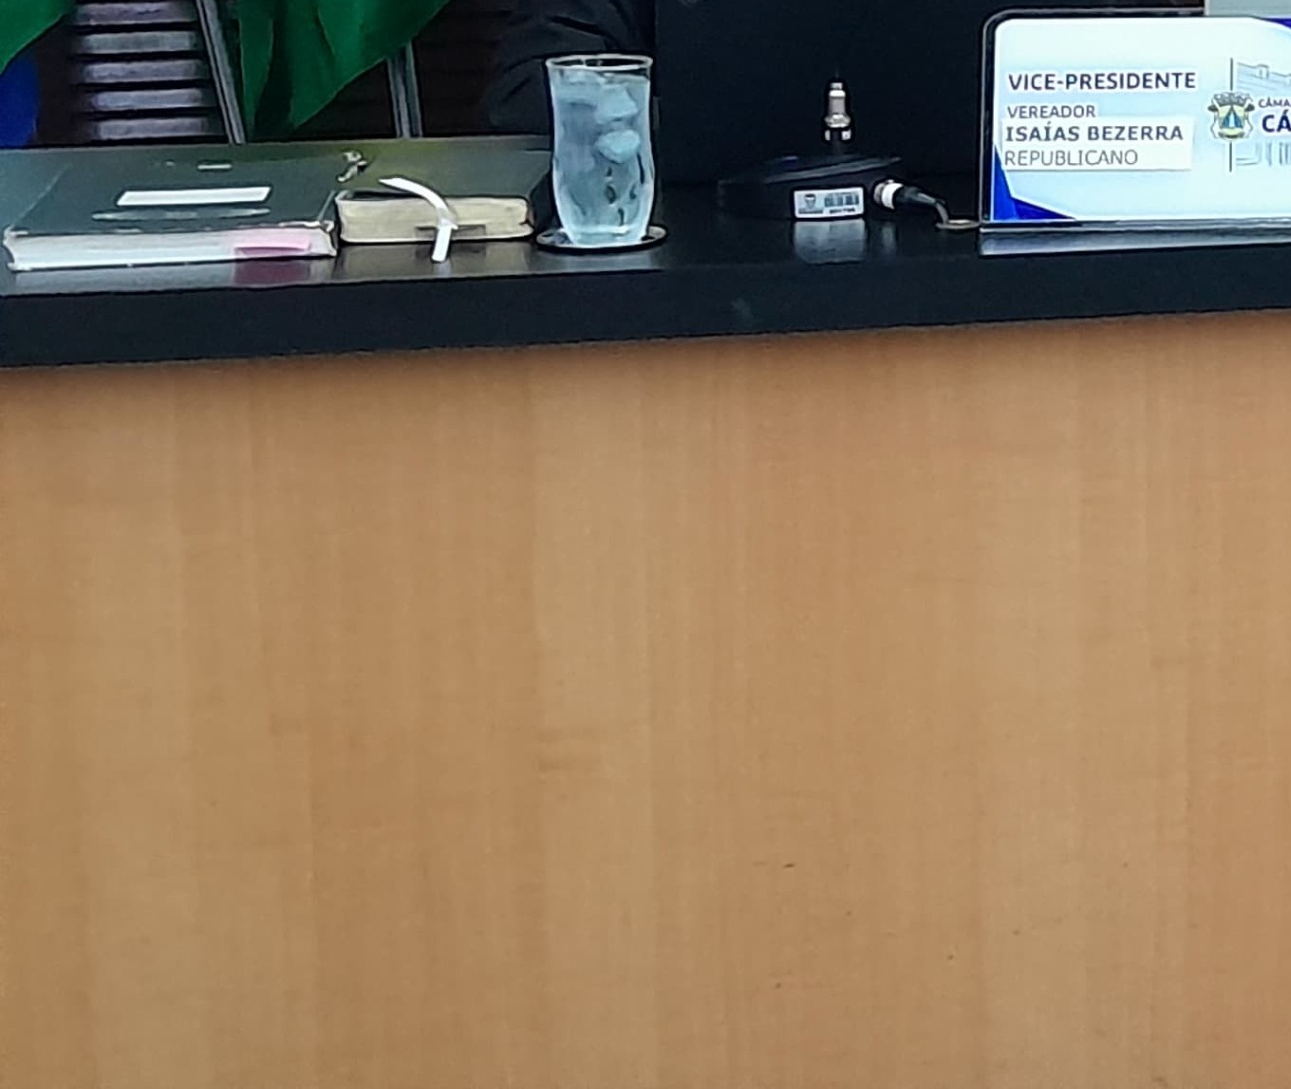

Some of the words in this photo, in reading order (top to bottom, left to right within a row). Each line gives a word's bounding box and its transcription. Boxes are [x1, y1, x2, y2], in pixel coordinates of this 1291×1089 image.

[1008, 72, 1196, 91] VICE-PRESIDENTE
[1007, 105, 1096, 119] VEREADOR
[1005, 121, 1080, 142] ISAÍAS
[1087, 125, 1184, 141] BEZERRA
[1004, 149, 1138, 166] REPUBLICANO
